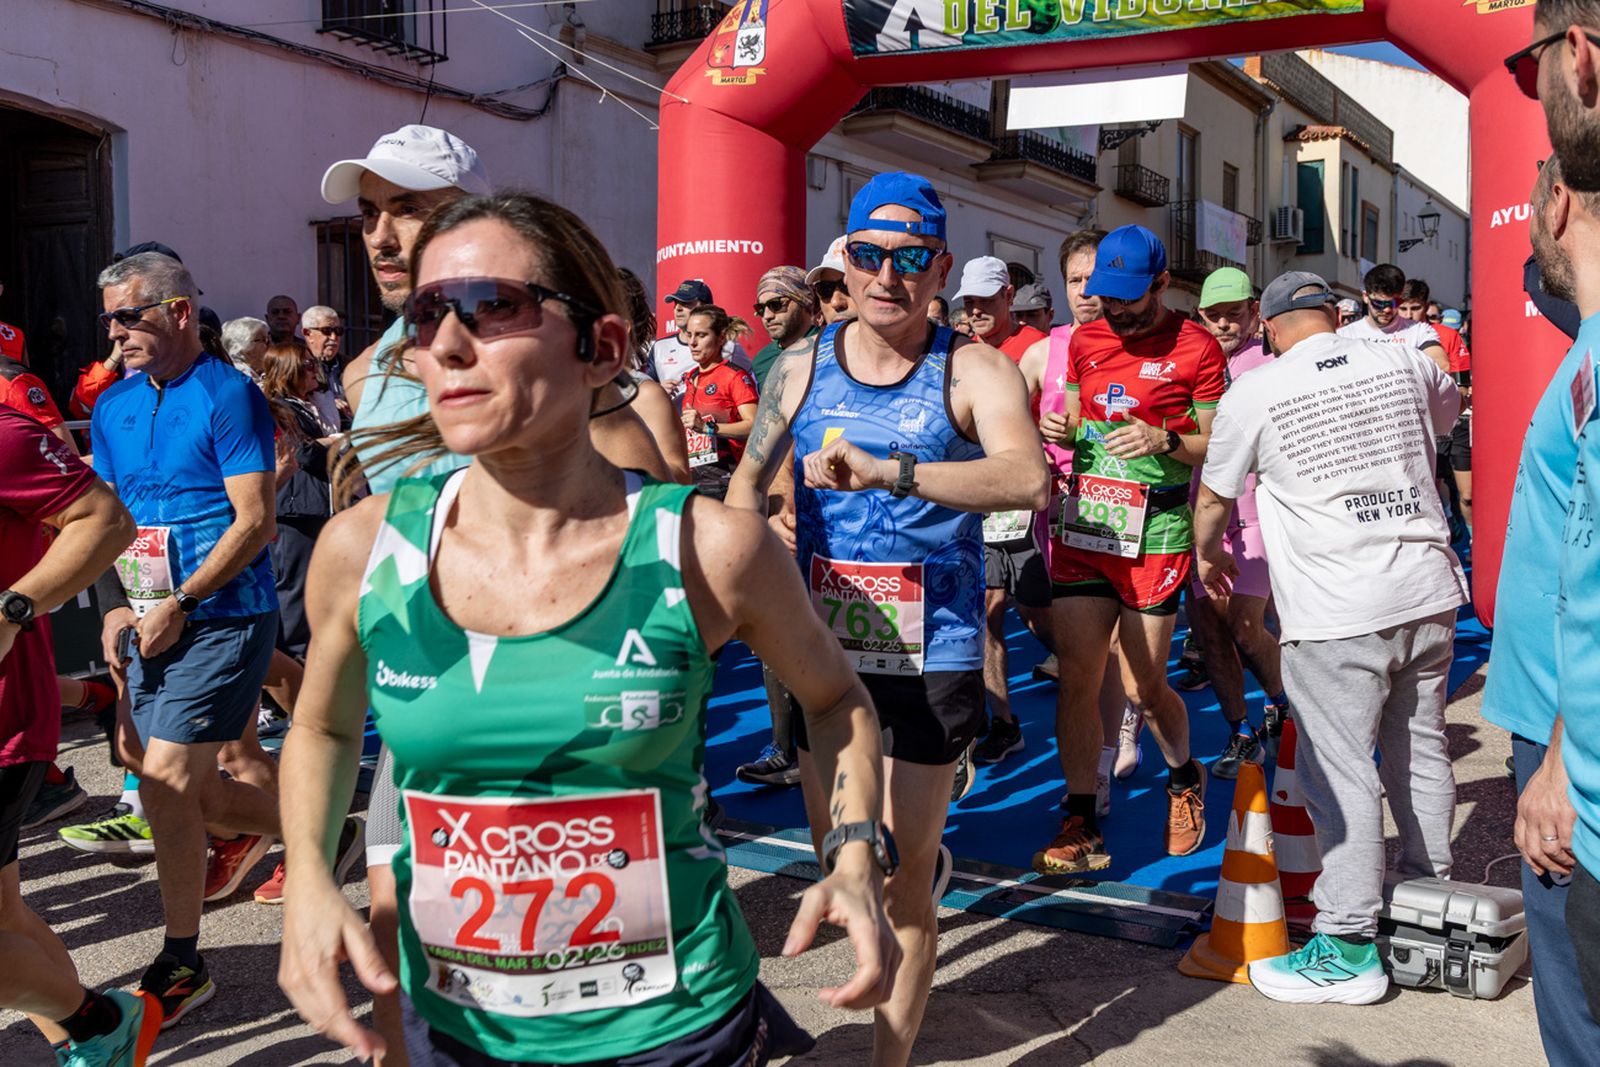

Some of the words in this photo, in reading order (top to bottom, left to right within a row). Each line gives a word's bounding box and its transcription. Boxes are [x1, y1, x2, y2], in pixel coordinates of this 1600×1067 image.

[942, 0, 1031, 36] DEL
[720, 76, 747, 84] MARTOS
[1315, 354, 1349, 372] PONY
[1271, 408, 1301, 423] BROKEN
[1301, 401, 1320, 412] NEW
[1320, 394, 1343, 405] YORK
[1343, 390, 1362, 400] WAS
[1362, 387, 1373, 395] TO
[1374, 381, 1393, 391] STAY
[1276, 400, 1293, 410] THE
[1292, 392, 1317, 404] EARLY
[1339, 382, 1355, 391] THE
[1355, 376, 1375, 387] ONLY
[1375, 370, 1395, 380] RULE
[1296, 411, 1321, 424] WHEN
[1321, 404, 1344, 415] PONY
[1344, 399, 1367, 409] FIRST
[1369, 388, 1407, 403] APPEARED
[1279, 442, 1296, 453] REAL
[1329, 424, 1348, 434] NEW
[1348, 415, 1384, 429] YORKERS
[1384, 408, 1411, 420] SLIPPED
[1281, 429, 1300, 441] WITH
[1300, 417, 1338, 433] ORIGINAL
[1339, 405, 1380, 421] SNEAKERS
[1380, 397, 1414, 411] DESIGNED
[687, 435, 711, 454] 320
[1287, 446, 1311, 460] BRAND
[1312, 439, 1332, 450] THEY
[1333, 428, 1373, 444] IDENTIFIED
[1296, 466, 1315, 478] PONY
[1316, 461, 1334, 471] HAS
[1334, 455, 1358, 466] SINCE
[1359, 442, 1403, 459] SYMBOLIZED
[1297, 459, 1308, 467] TO
[1308, 447, 1340, 463] SURVIVE
[1341, 443, 1358, 453] THE
[1358, 437, 1383, 450] TOUGH
[1383, 432, 1401, 443] CITY
[1312, 475, 1322, 483] OF
[1330, 468, 1348, 478] CITY
[1350, 463, 1369, 473] THAT
[1370, 457, 1393, 468] NEVER
[1080, 478, 1092, 493] X
[1091, 484, 1132, 500] CROSS
[1345, 489, 1403, 512] PRODUCT
[1075, 499, 1128, 532] 293
[1356, 508, 1381, 523] NEW
[1386, 501, 1421, 518] YORK
[821, 563, 834, 587] X
[837, 574, 901, 592] CROSS
[820, 585, 886, 604] PANTANO
[823, 598, 900, 640] 763
[438, 808, 478, 850] X
[481, 815, 616, 856] CROSS
[444, 850, 586, 881] PANTANO
[590, 852, 608, 867] DE
[450, 872, 620, 951] 272
[466, 952, 493, 967] DEL
[495, 957, 528, 970] MAR
